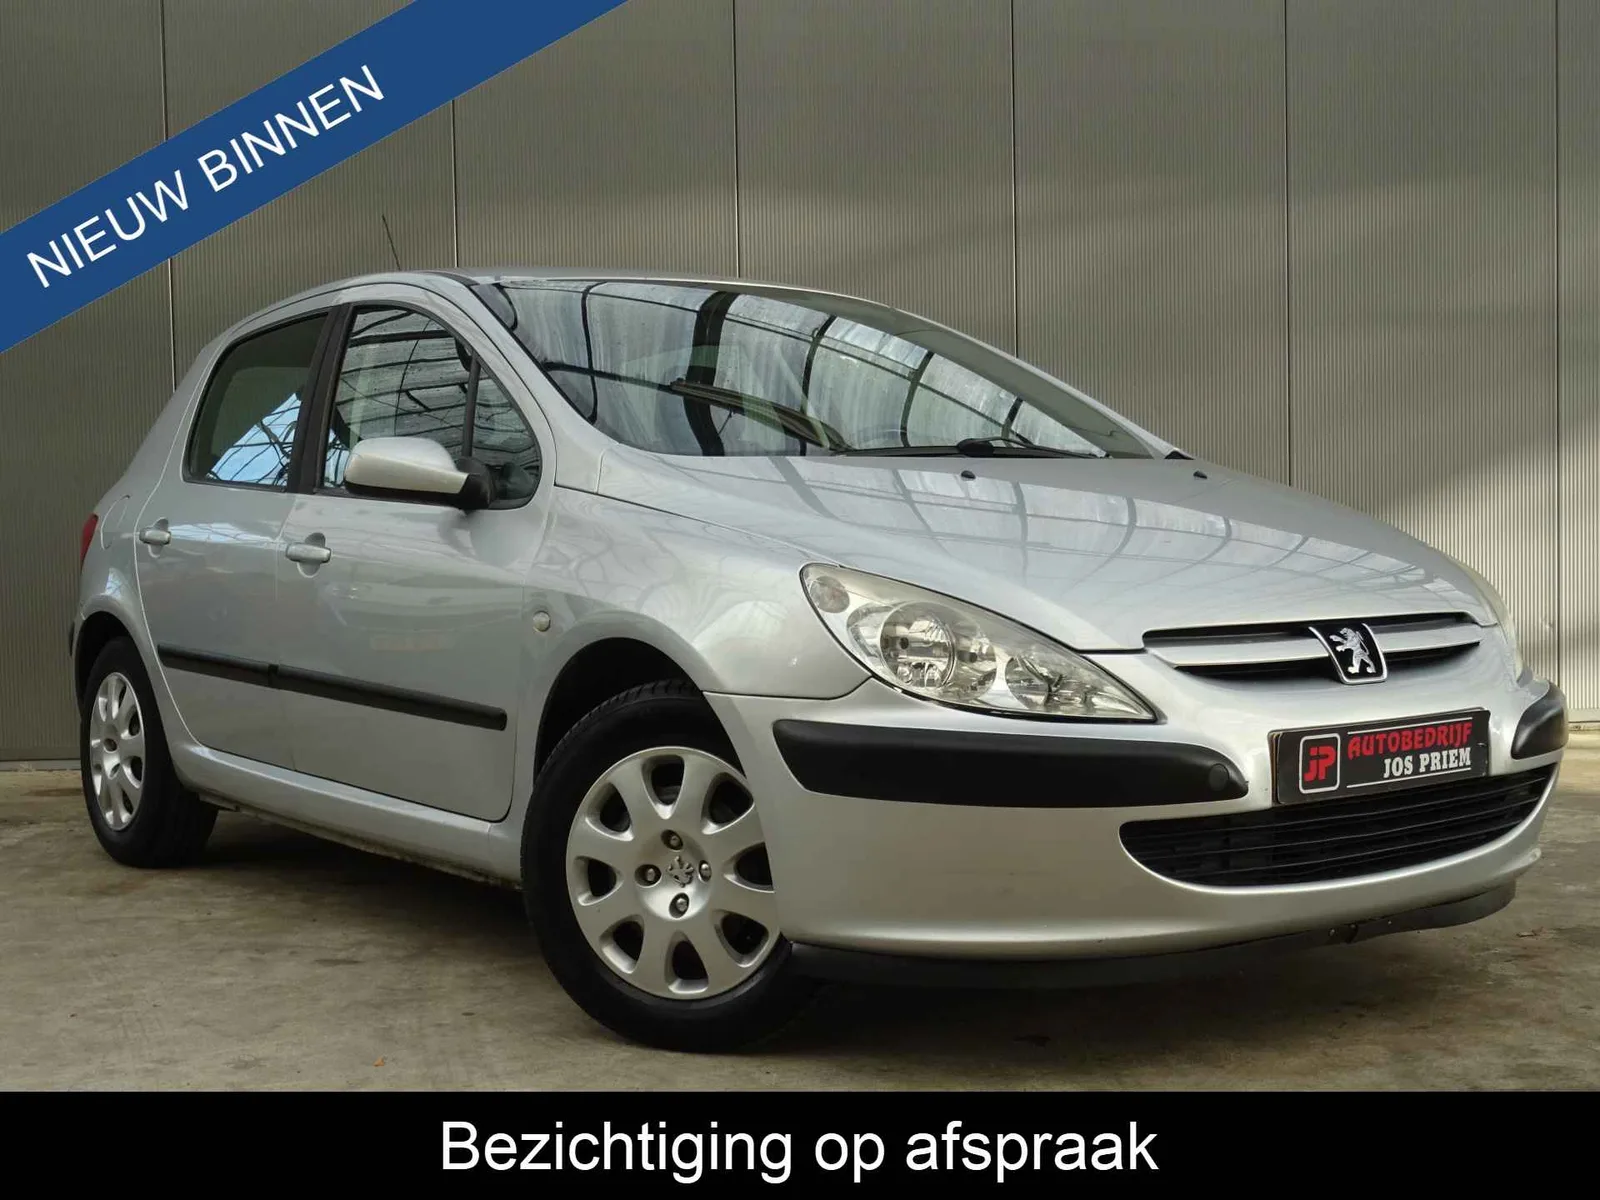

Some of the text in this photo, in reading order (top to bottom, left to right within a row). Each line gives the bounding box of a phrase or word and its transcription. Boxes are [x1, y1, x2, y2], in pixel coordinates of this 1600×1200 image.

[1347, 722, 1473, 760] AUTOBEDRIJF
[1383, 747, 1472, 778] JOS PRIEM
